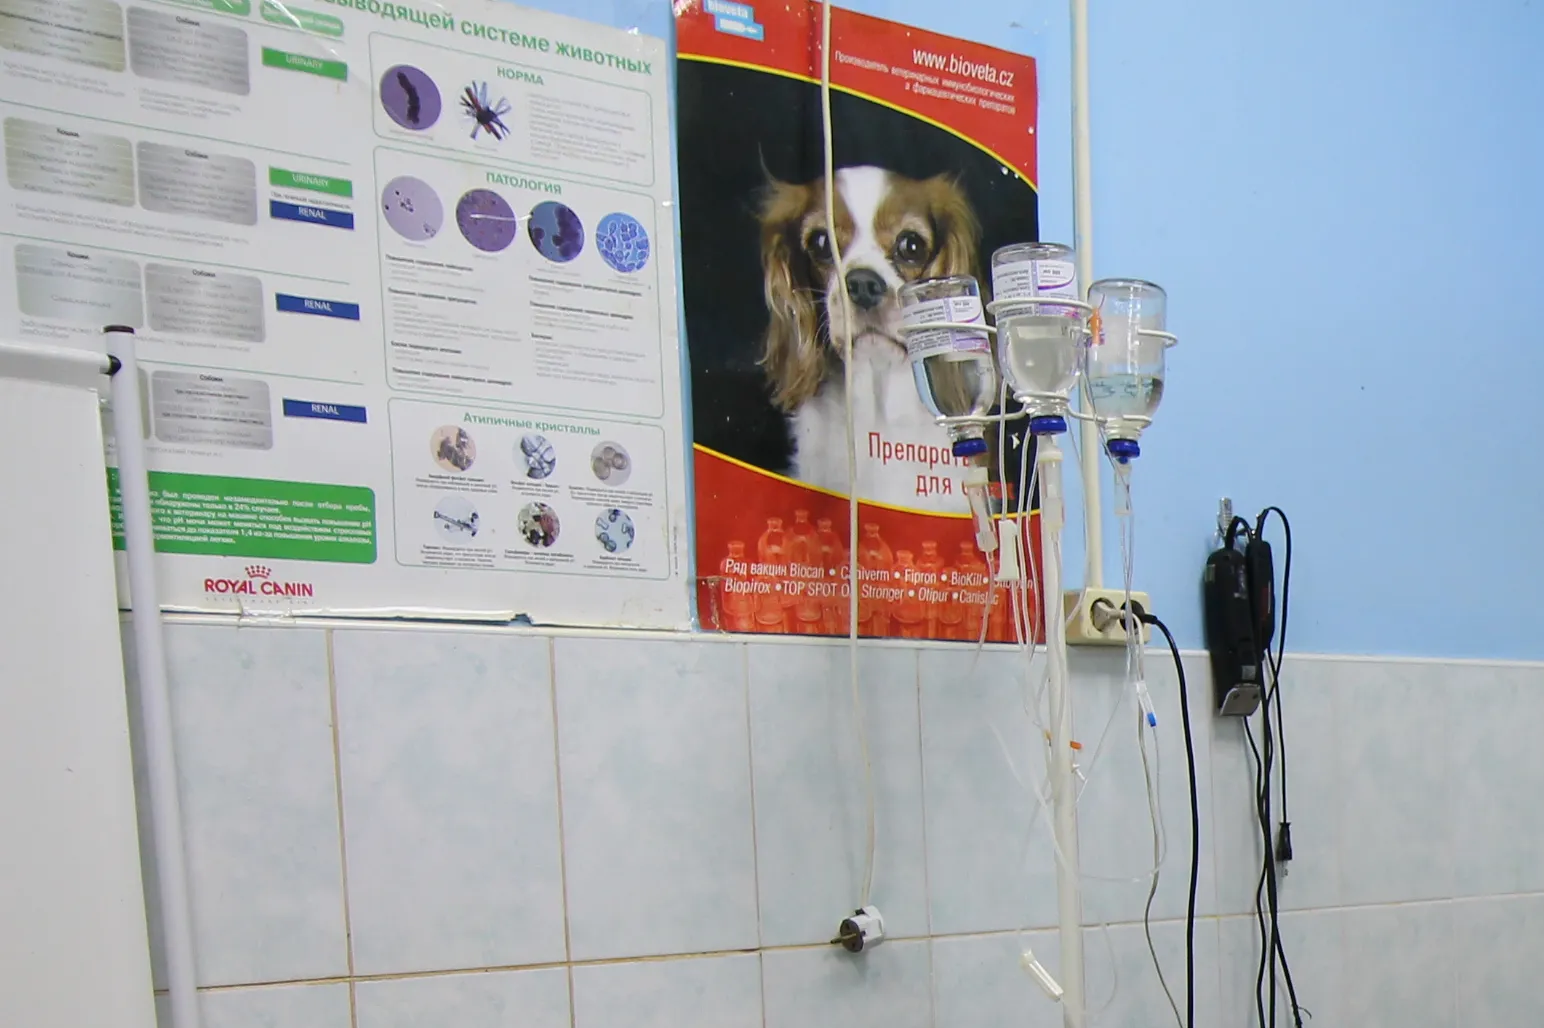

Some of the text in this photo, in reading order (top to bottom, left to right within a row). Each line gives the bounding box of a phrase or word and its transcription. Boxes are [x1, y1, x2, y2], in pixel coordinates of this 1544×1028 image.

[461, 20, 549, 53] системе
[555, 41, 652, 75] животных
[286, 55, 323, 69] URINARY
[913, 48, 1015, 87] www.bioveta.cz
[497, 66, 544, 85] НОРМА
[293, 173, 329, 188] URINARY
[486, 172, 562, 195] ПАТОЛОГИЯ
[299, 207, 326, 220] RENAL
[304, 299, 332, 312] RENAL
[311, 404, 339, 416] RENAL
[464, 412, 600, 435] Атипичные кристаллы
[868, 432, 972, 469] Препара
[916, 475, 952, 497] для
[725, 558, 748, 576] Ряд
[751, 563, 787, 577] вакцин
[790, 563, 824, 579] Biocan
[841, 565, 890, 581] Cniverm
[905, 569, 936, 586] Fipron
[951, 571, 982, 587] BioKill
[204, 578, 313, 597] ROYAL CANIN
[725, 577, 771, 596] Biopirox
[783, 581, 805, 596] TOP
[808, 582, 837, 597] SPOT
[862, 584, 904, 602] Stronger
[918, 587, 949, 604] Otipur
